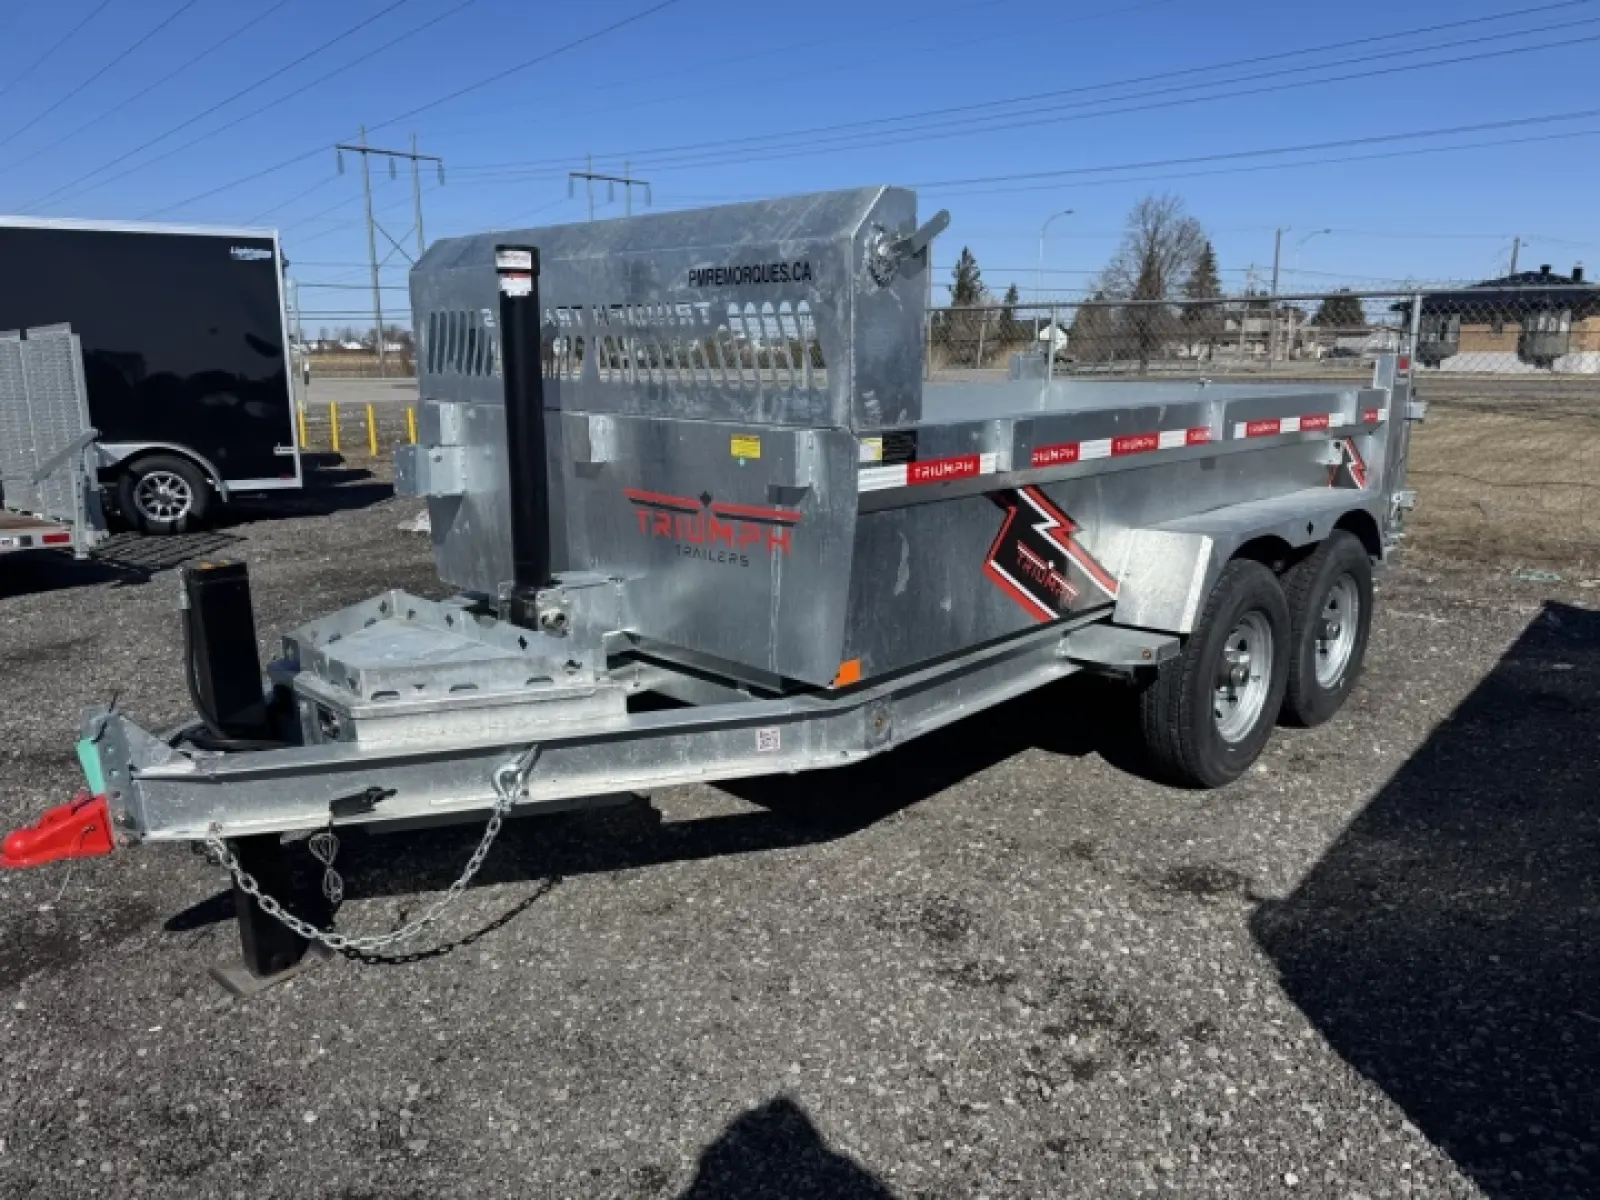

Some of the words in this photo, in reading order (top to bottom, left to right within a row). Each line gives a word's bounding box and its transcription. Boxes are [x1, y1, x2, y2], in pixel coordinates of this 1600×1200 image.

[688, 261, 812, 287] PMREMORQUES.CA
[914, 459, 975, 480] TRIUMPH
[635, 508, 793, 557] TRIUMPH
[675, 544, 750, 568] TRAILERS
